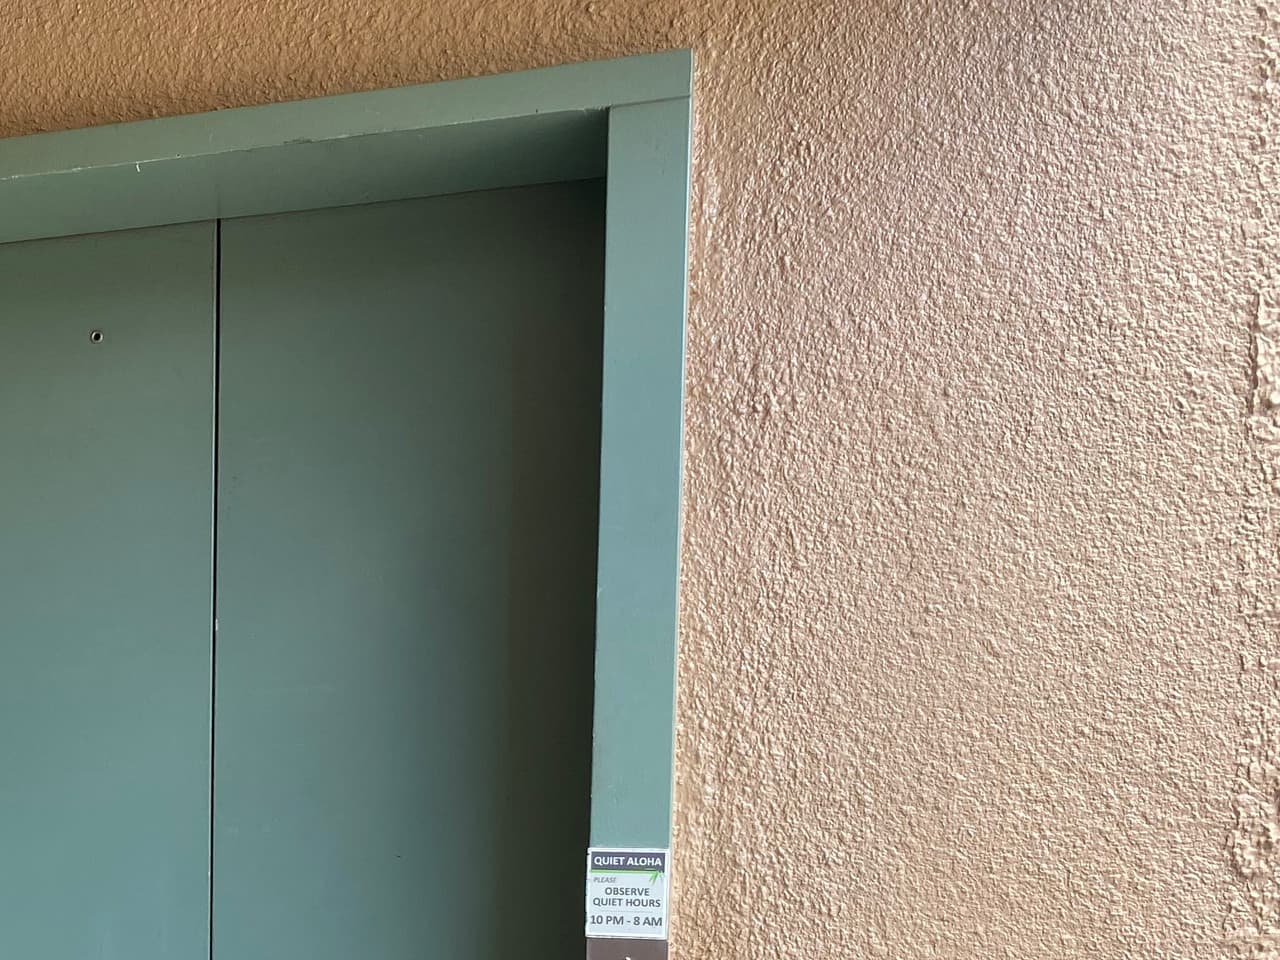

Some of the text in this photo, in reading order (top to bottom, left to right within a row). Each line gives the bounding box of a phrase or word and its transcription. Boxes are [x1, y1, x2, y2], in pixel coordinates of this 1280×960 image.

[594, 856, 662, 866] QUIET ALOHA
[593, 876, 617, 884] PLEASE
[604, 887, 650, 896] OBSERVE
[592, 897, 661, 908] QUIET HOURS
[590, 915, 603, 925] 10
[606, 915, 624, 925] PM
[633, 916, 640, 926] 8
[643, 917, 663, 926] AM
